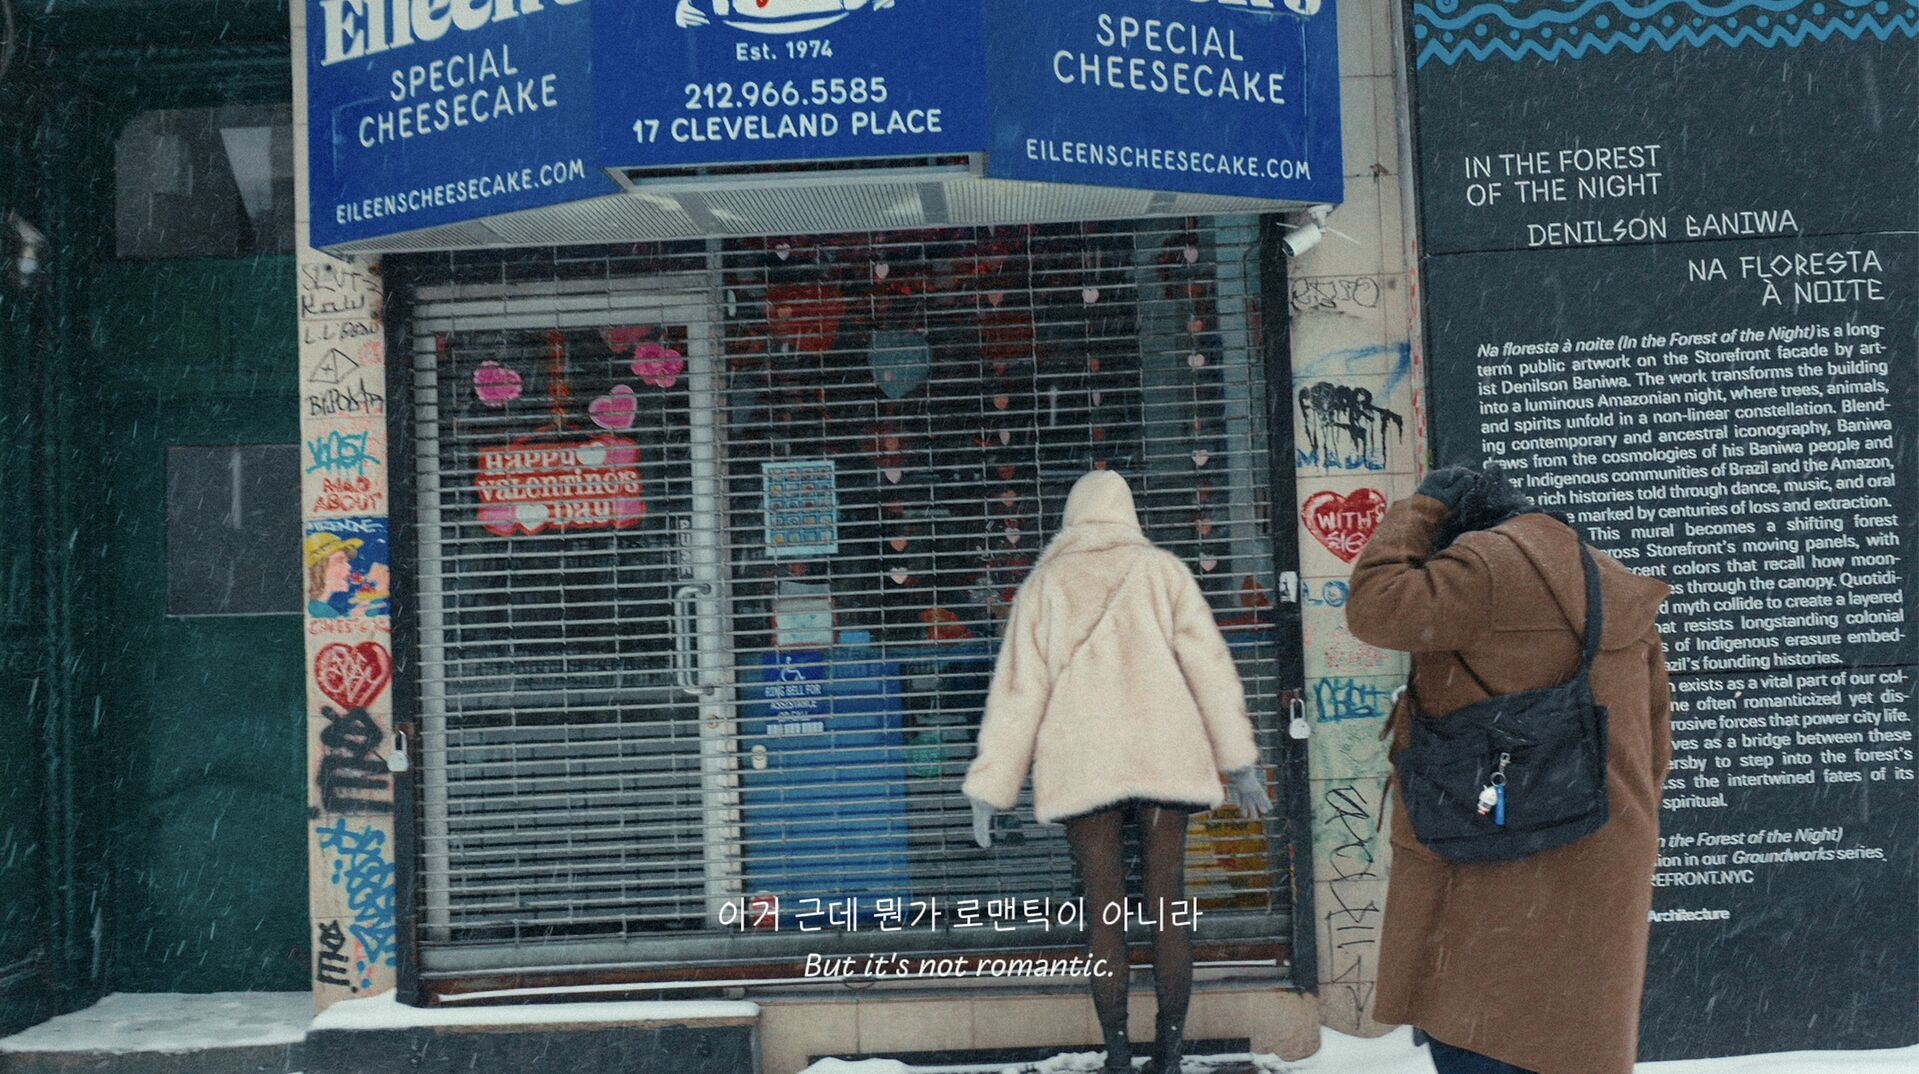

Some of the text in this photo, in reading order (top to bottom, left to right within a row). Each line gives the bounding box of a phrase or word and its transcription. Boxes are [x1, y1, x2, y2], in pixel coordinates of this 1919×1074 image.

[736, 40, 833, 61] Est. 1974
[1097, 14, 1244, 61] SPECIAL
[390, 43, 518, 100] SPECIAL
[1053, 50, 1286, 105] CHEESECAKE
[684, 77, 888, 110] 212.966.5585
[358, 73, 557, 149] CHEESECAKE
[632, 109, 942, 144] 17 CLEVELAND PLACE
[1026, 139, 1312, 181] EILEENSCHEESECAKE.COM
[1465, 145, 1660, 178] IN THE FOREST
[336, 158, 585, 225] EILEENSCHEESECAKE.COM
[1466, 173, 1662, 207] OF THE NIGHT
[1528, 217, 1667, 247] DENILSON
[1688, 250, 1883, 282] NA FLORESTA
[1795, 279, 1885, 304] NOITE
[1477, 322, 1884, 356] Na floresta noite (In Forest Night) long-
[1477, 345, 1828, 377] term public artwork Storefront facade
[1502, 360, 1888, 394] Denilson Baniwa. The work transforms building
[1525, 380, 1889, 411] luminous Amazonian night, where trees, animals,
[1514, 399, 1890, 434] spirits unfold non-linear constellation. Blend-
[1511, 417, 1892, 453] contemporary ancestral iconography, Baniwa
[1532, 452, 1567, 467] from
[1602, 445, 1697, 467] cosmologies
[1750, 440, 1803, 455] Baniwa
[1809, 437, 1860, 456] people
[1527, 469, 1609, 490] Indigenous
[1612, 465, 1708, 482] communities
[1729, 462, 1768, 477] Brazil
[1830, 456, 1894, 476] Amazon,
[1538, 491, 1566, 506] rich
[1570, 487, 1634, 504] histories
[1637, 486, 1666, 500] told
[1670, 482, 1728, 502] through
[1731, 480, 1780, 499] dance,
[1784, 477, 1832, 496] music,
[1867, 473, 1895, 488] oral
[1316, 512, 1371, 530] WITH
[1578, 506, 1634, 522] marked
[1658, 502, 1728, 518] centuries
[1749, 500, 1780, 515] loss
[1814, 495, 1892, 512] extraction.
[1588, 512, 1898, 539] This mural becomes shifting forest
[1647, 539, 1736, 555] Storefront's
[1743, 536, 1799, 555] moving
[1805, 534, 1859, 552] panels,
[1866, 532, 1899, 547] with
[1673, 559, 1720, 574] colors
[1764, 555, 1805, 570] recall
[1851, 555, 1900, 567] moon-
[1687, 577, 1746, 596] through
[1778, 576, 1837, 592] canopy.
[1840, 570, 1902, 586] Quotidi-
[1673, 598, 1710, 616] myth
[1713, 595, 1763, 611] collide
[1785, 592, 1832, 607] create
[1849, 589, 1903, 608] layered
[1684, 616, 1734, 631] resists
[1741, 611, 1838, 632] longstanding
[1845, 609, 1904, 624] colonial
[1696, 628, 1905, 652] Indigenous erasure embed-
[1702, 653, 1770, 672] founding
[1773, 651, 1843, 666] histories.
[1679, 675, 1723, 690] exists
[1760, 673, 1793, 687] vital
[1796, 672, 1828, 689] part
[1696, 695, 1736, 709] often
[1744, 692, 1841, 708] romanticized
[1719, 714, 1767, 728] forces
[1802, 714, 1851, 729] power
[1853, 710, 1881, 727] city
[1884, 709, 1910, 723] life.
[1742, 728, 1912, 751] bridge between these
[1740, 747, 1913, 770] step forest's
[1728, 769, 1862, 787] intertwined fates
[1663, 794, 1728, 811] spiritual.
[1697, 827, 1843, 846] Forest Night)
[1732, 846, 1887, 864] Groundworks series.
[1648, 906, 1730, 921] Architecture
